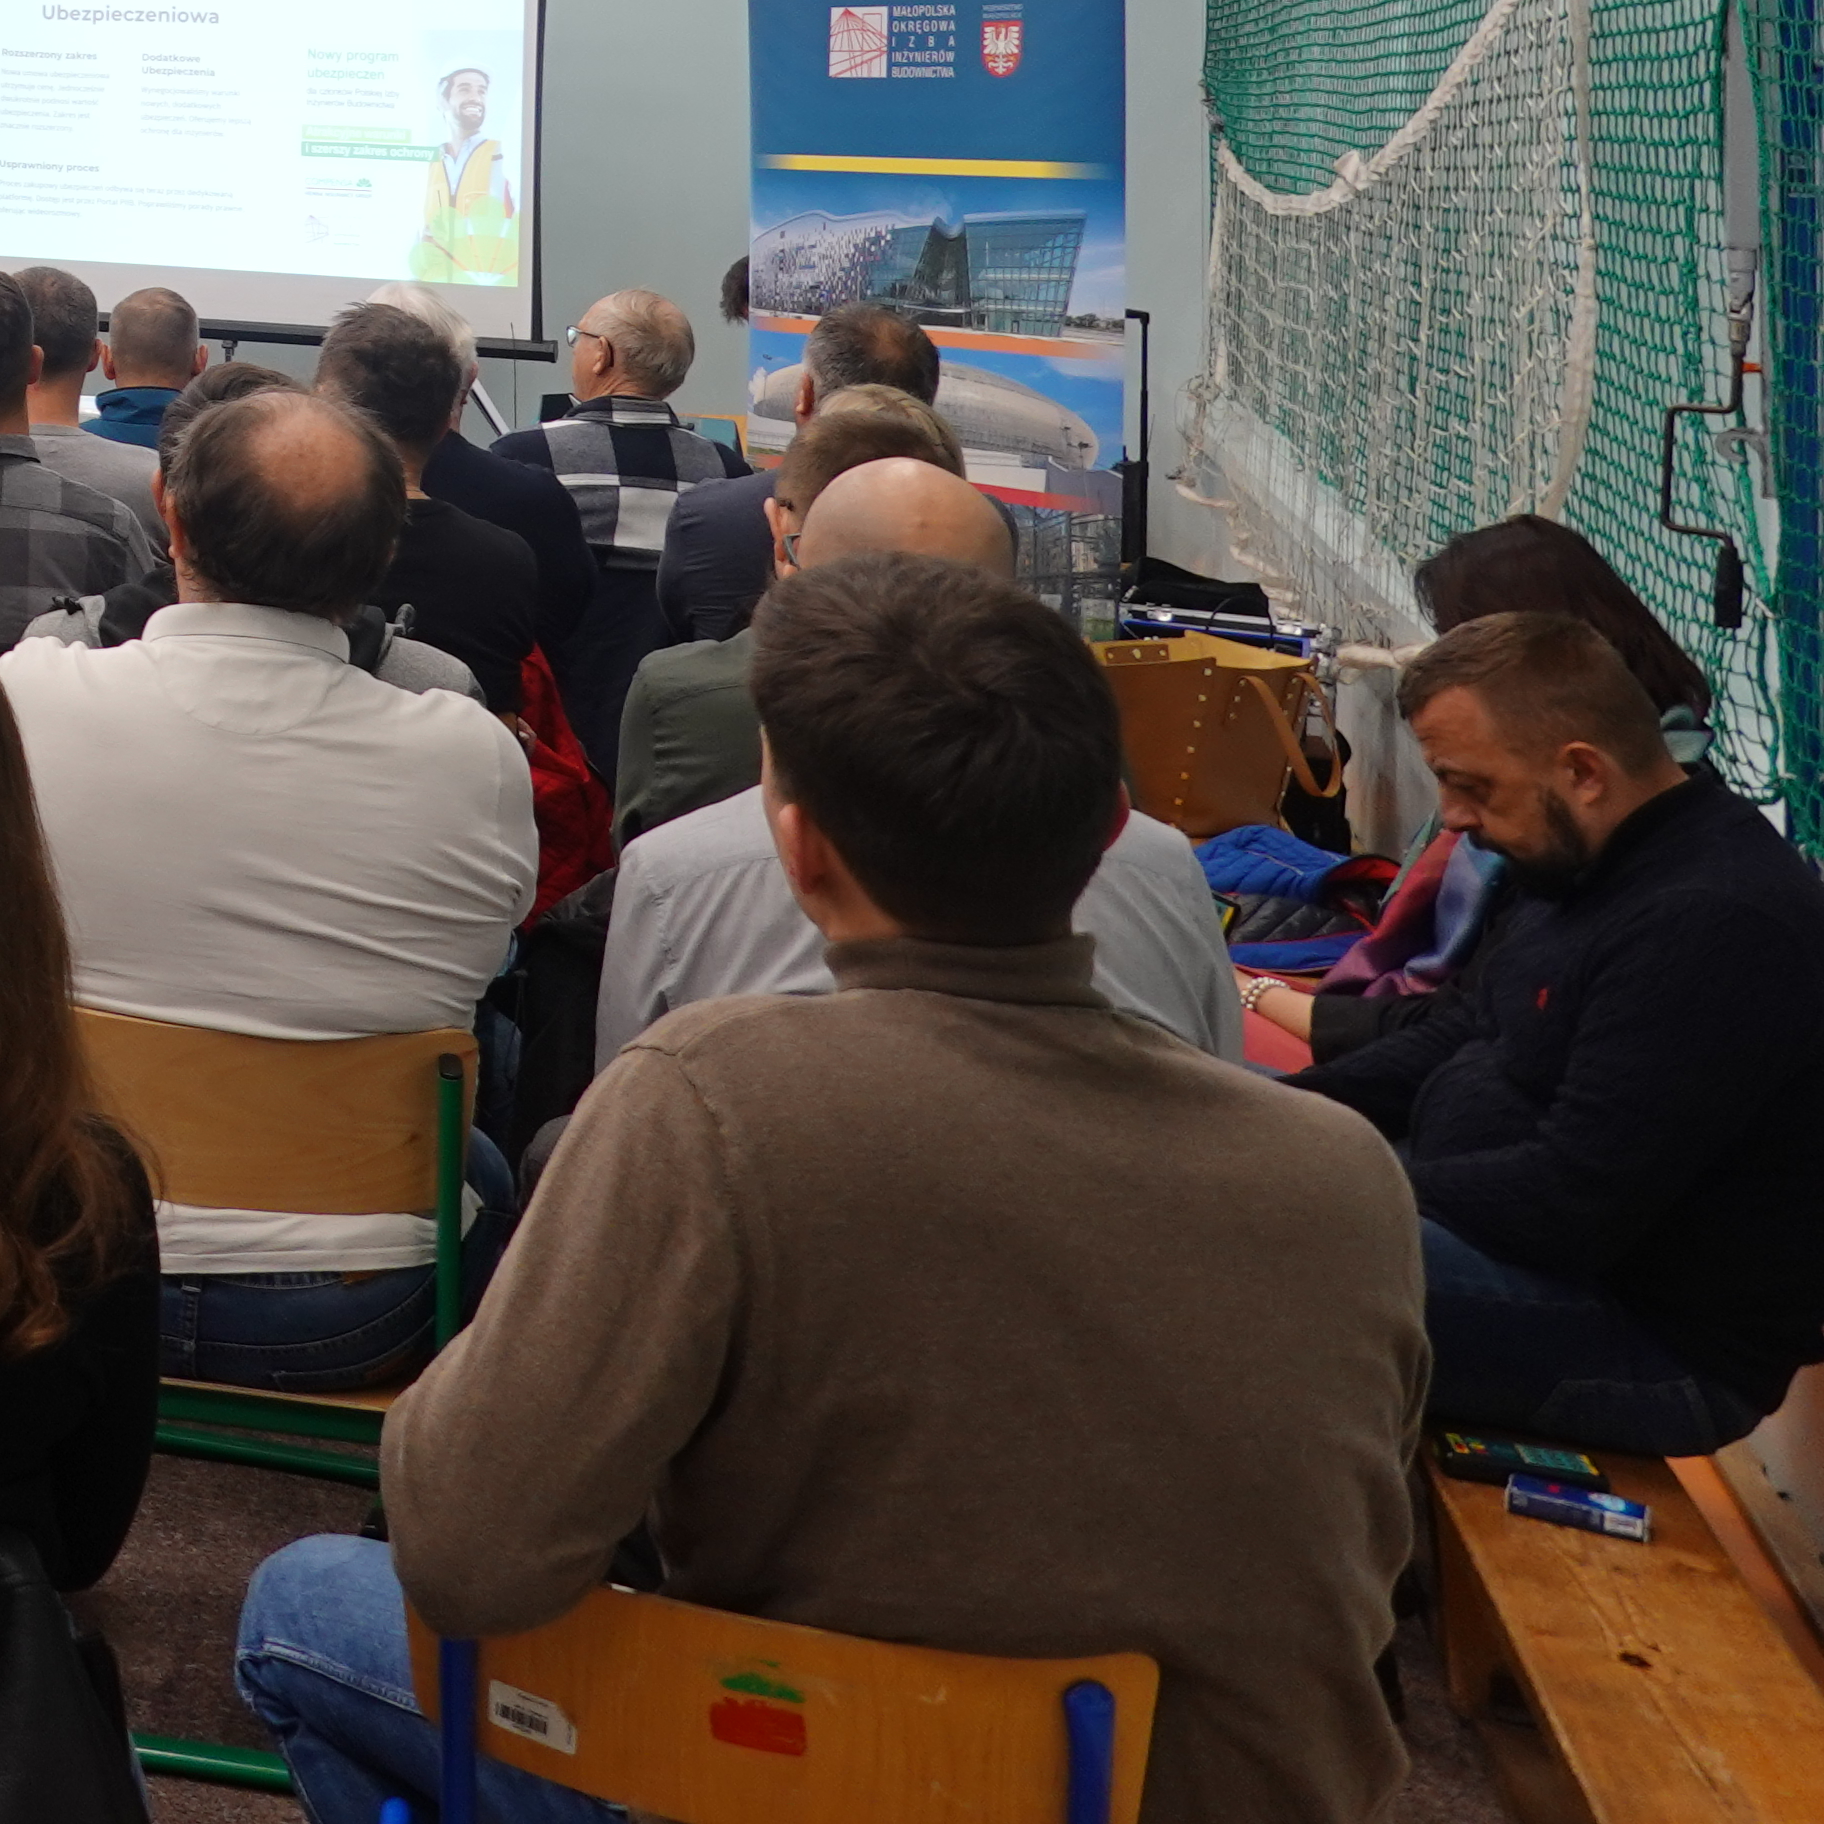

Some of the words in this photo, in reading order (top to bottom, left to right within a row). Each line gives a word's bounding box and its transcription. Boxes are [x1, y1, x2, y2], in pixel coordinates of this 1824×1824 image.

[42, 5, 220, 25] Ubezpieczeniowa
[893, 4, 956, 17] MAŁOPOLSKA
[892, 20, 956, 34] OKRĘGOWA
[1, 48, 62, 61] Rozszerzony
[65, 51, 97, 60] zakres
[141, 53, 201, 64] Dodatkowe
[307, 48, 342, 63] Nowy
[346, 51, 399, 64] program
[892, 49, 955, 63] INŻYNIERÓW
[141, 65, 216, 78] Ubezpieczenia
[892, 66, 954, 78] BUDOWNICTWA
[311, 143, 350, 157] szerszy
[353, 145, 387, 157] zakres
[390, 147, 435, 160] ochrony
[0, 159, 64, 173] Usprawniony
[66, 163, 100, 173] proces
